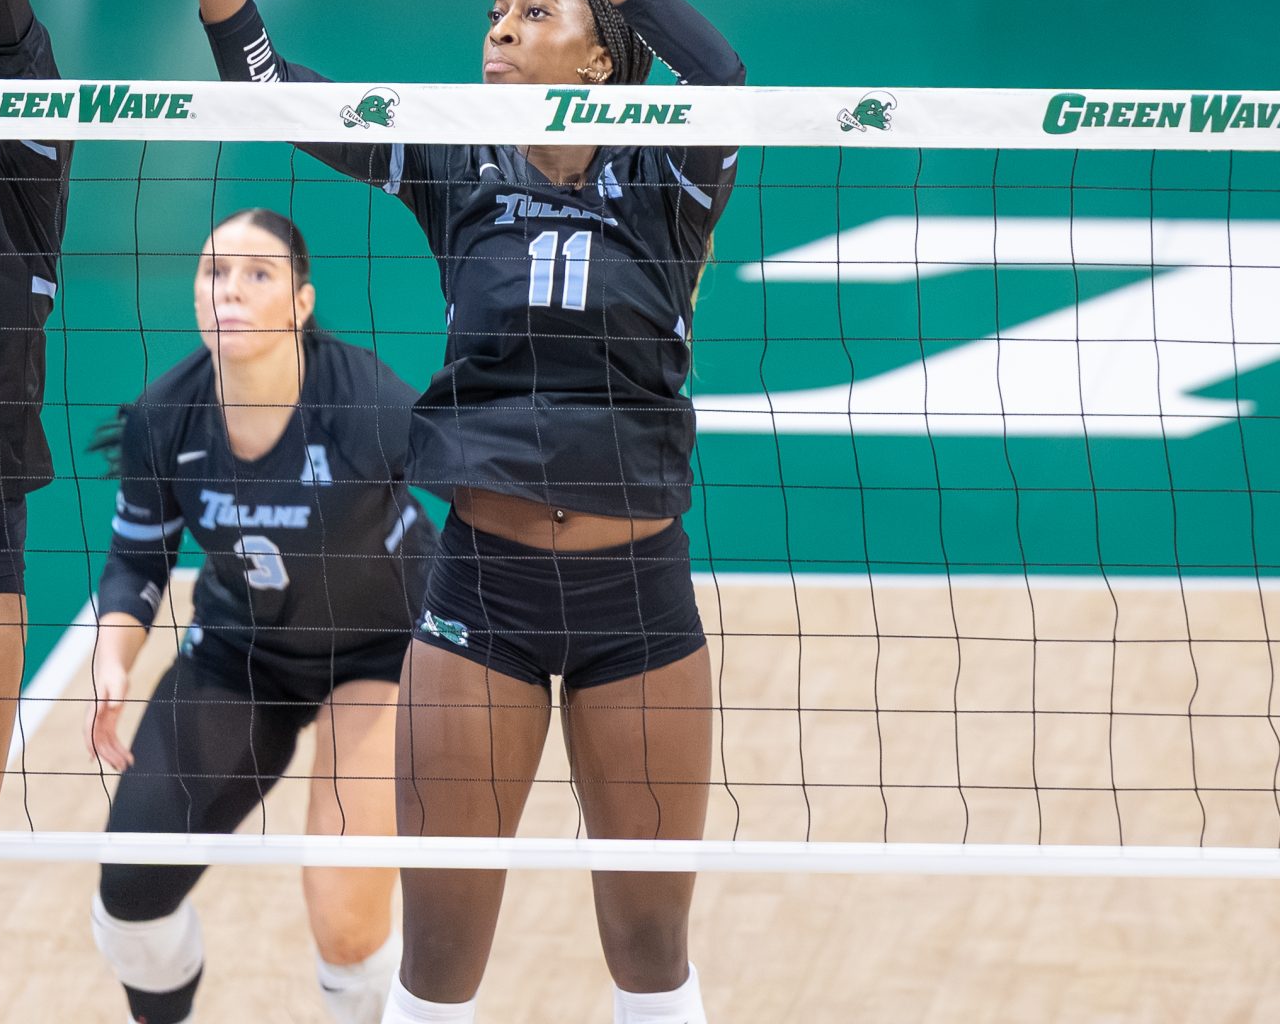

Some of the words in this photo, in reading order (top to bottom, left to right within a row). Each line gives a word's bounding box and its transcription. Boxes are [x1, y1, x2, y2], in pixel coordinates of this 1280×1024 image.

[243, 27, 281, 83] TULA
[545, 88, 691, 131] TULANE
[1042, 92, 1186, 135] GREEN
[1189, 94, 1280, 133] WAV
[494, 193, 619, 227] TULA
[528, 230, 592, 311] 11
[199, 489, 312, 530] TULANE
[233, 535, 291, 591] 3
